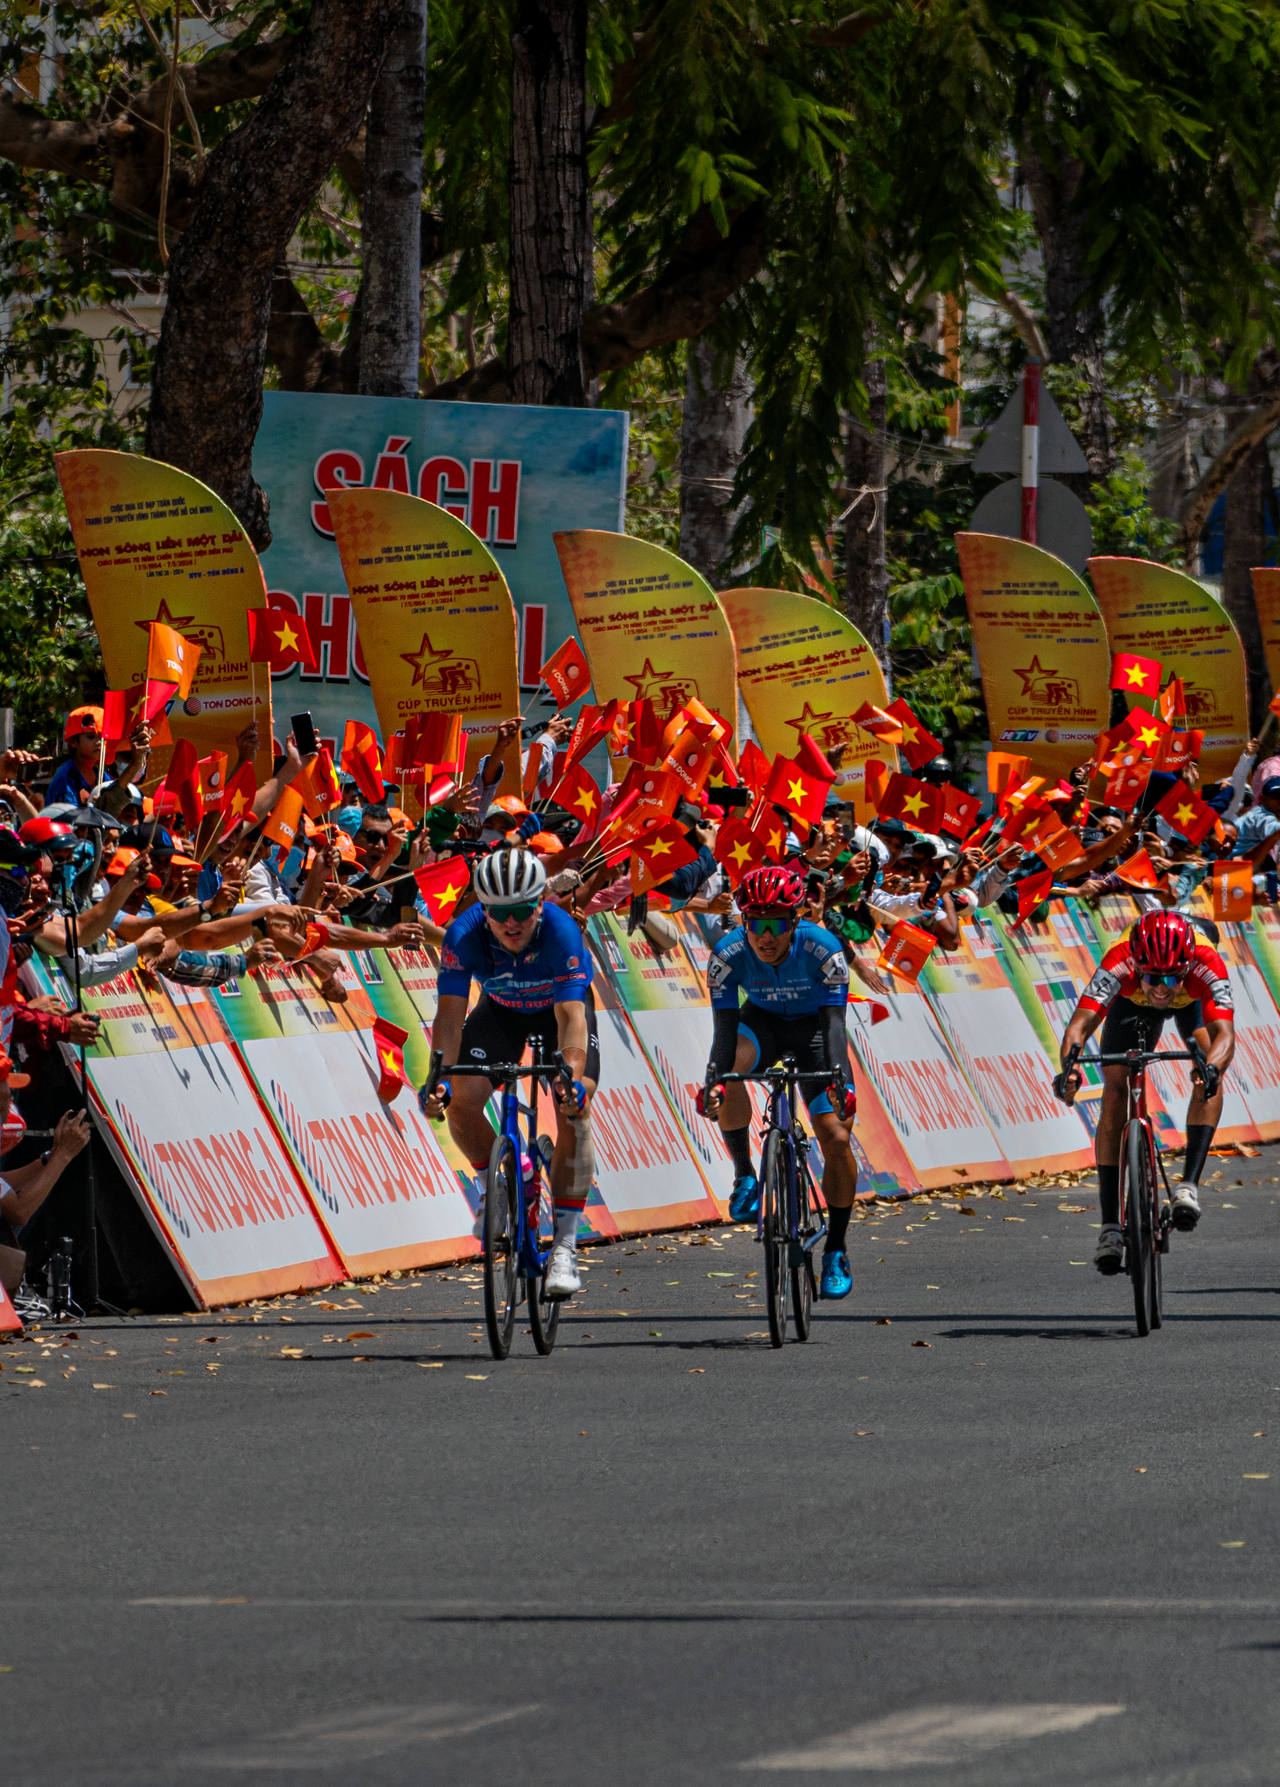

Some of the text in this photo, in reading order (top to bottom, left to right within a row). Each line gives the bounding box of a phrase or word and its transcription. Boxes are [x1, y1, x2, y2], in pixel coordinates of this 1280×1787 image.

[311, 436, 521, 544] SÁCH
[81, 547, 110, 558] NON
[115, 542, 151, 554] SÔNG
[156, 536, 182, 550] LIỀN
[187, 534, 216, 548] MỘT
[353, 584, 379, 595] NON
[383, 581, 416, 592] SÔNG
[449, 574, 474, 587] MỘT
[579, 616, 604, 626] NON
[608, 612, 638, 622] SÔNG
[670, 605, 695, 616] MỘT
[218, 662, 248, 673] HÌNH
[738, 668, 761, 678] NON
[823, 650, 846, 661] MỘT
[203, 700, 222, 708] TON
[225, 698, 253, 708] DONG
[398, 692, 502, 710] CÚP TRUYỀN HÌNH
[1008, 707, 1027, 715] CÚP
[1073, 707, 1096, 715] HÌNH
[576, 718, 585, 732] TON
[1001, 730, 1037, 740] HTV
[856, 742, 879, 752] HÌNH
[676, 766, 692, 785] DONG
[882, 1058, 984, 1133] TON DONG A
[974, 1055, 1027, 1126] TON
[998, 1051, 1059, 1122] DONG
[597, 1084, 672, 1169] DONG
[644, 1083, 687, 1162] A
[307, 1109, 456, 1209] TON DONG A
[154, 1127, 305, 1233] TON DONG A
